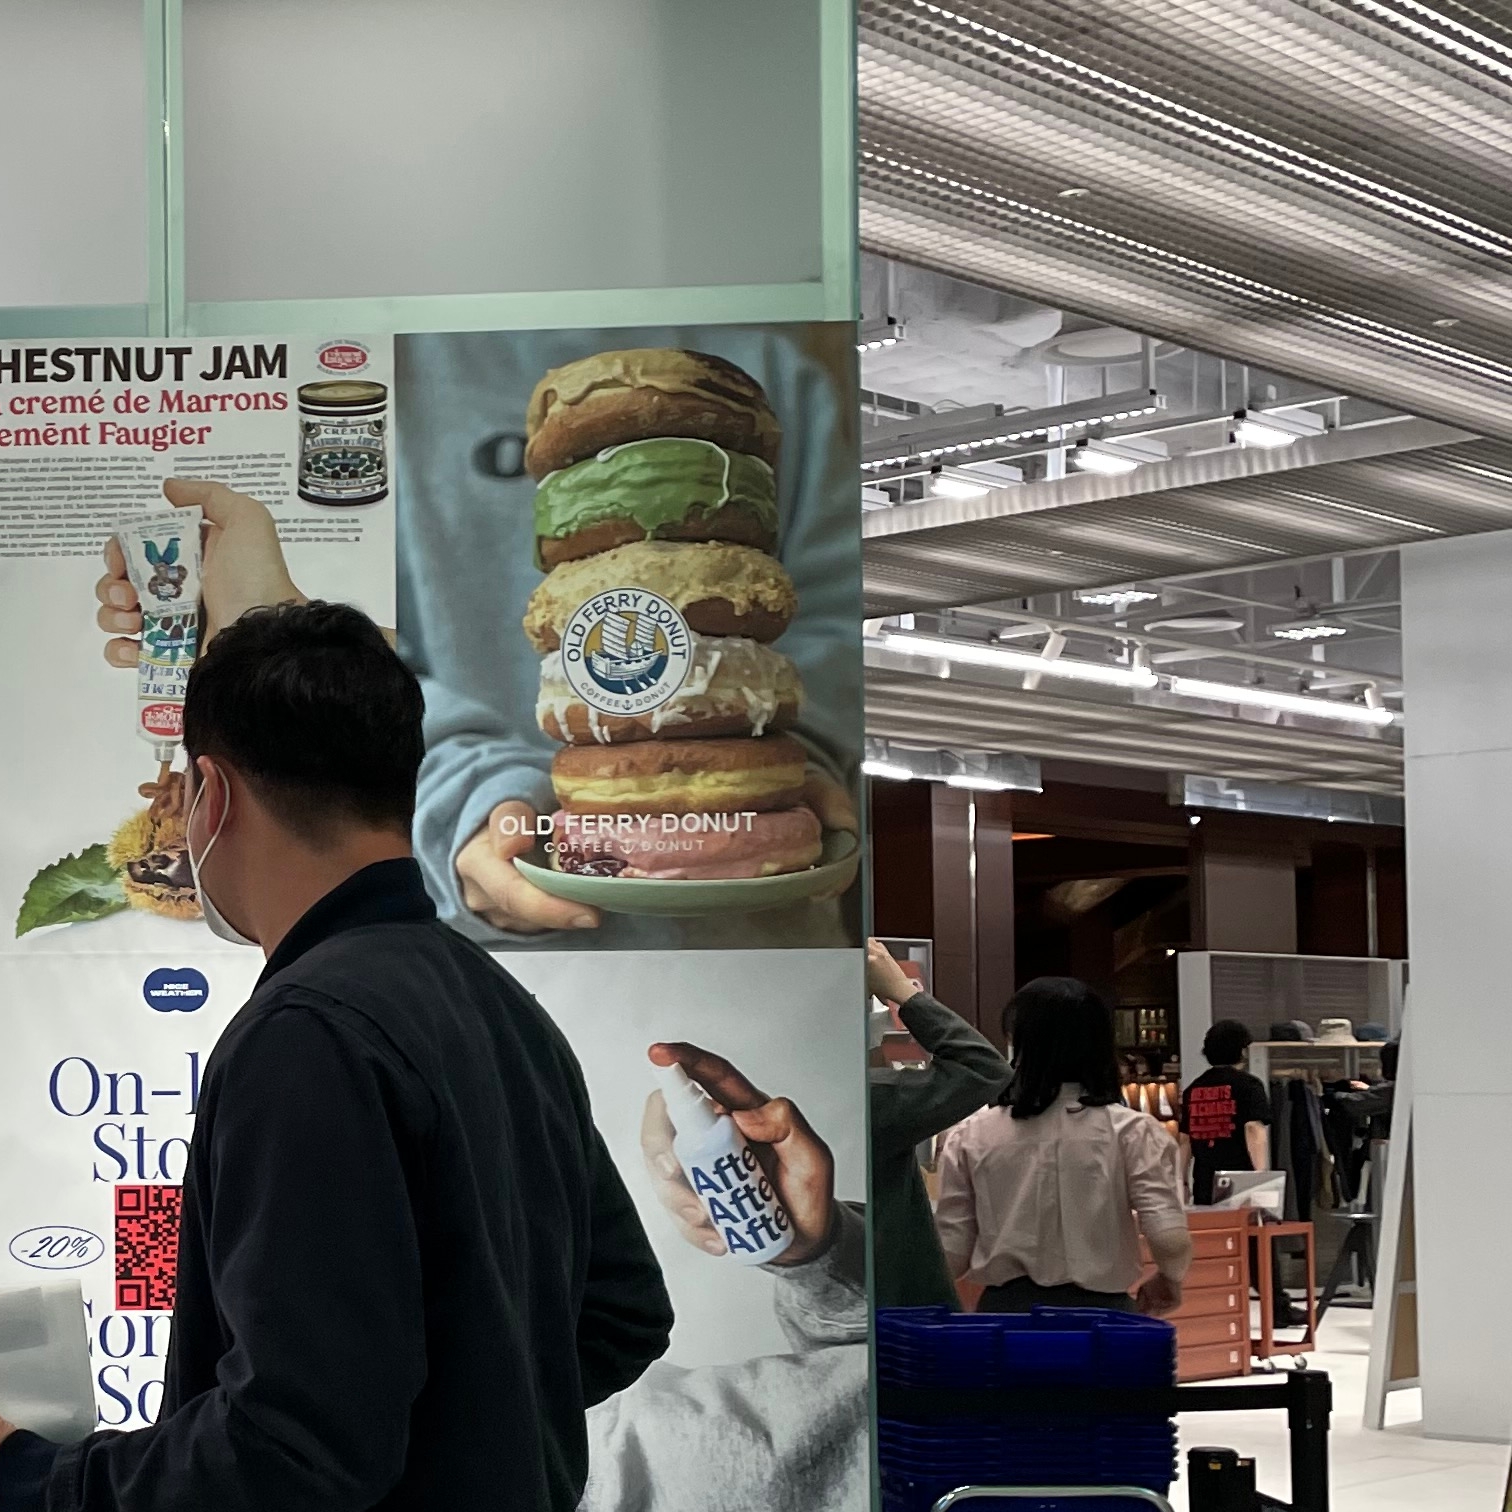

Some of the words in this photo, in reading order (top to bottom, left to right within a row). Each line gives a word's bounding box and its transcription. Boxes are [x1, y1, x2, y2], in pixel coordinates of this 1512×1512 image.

[199, 344, 287, 381] JAM
[9, 388, 105, 415] cremé
[113, 388, 151, 413] de
[159, 388, 288, 414] Marrons
[99, 420, 212, 452] Faugier
[567, 623, 586, 663] OLD
[583, 593, 642, 625] FERRY
[647, 599, 687, 660] DONUT
[580, 681, 622, 708] COFFEE
[635, 681, 672, 708] DONUT
[499, 815, 555, 836] OLD
[565, 813, 651, 835] FERRY
[661, 811, 758, 833] DONUT
[544, 840, 612, 853] COFFEE
[641, 839, 705, 852] DONUT
[150, 989, 203, 997] WEATHER
[49, 1052, 199, 1117] On-l
[93, 1123, 190, 1182] Sto
[691, 1146, 757, 1196] Afte
[707, 1176, 774, 1225] Afte
[20, 1235, 94, 1260] -20%
[724, 1205, 788, 1254] Afte
[96, 1364, 165, 1426] So
